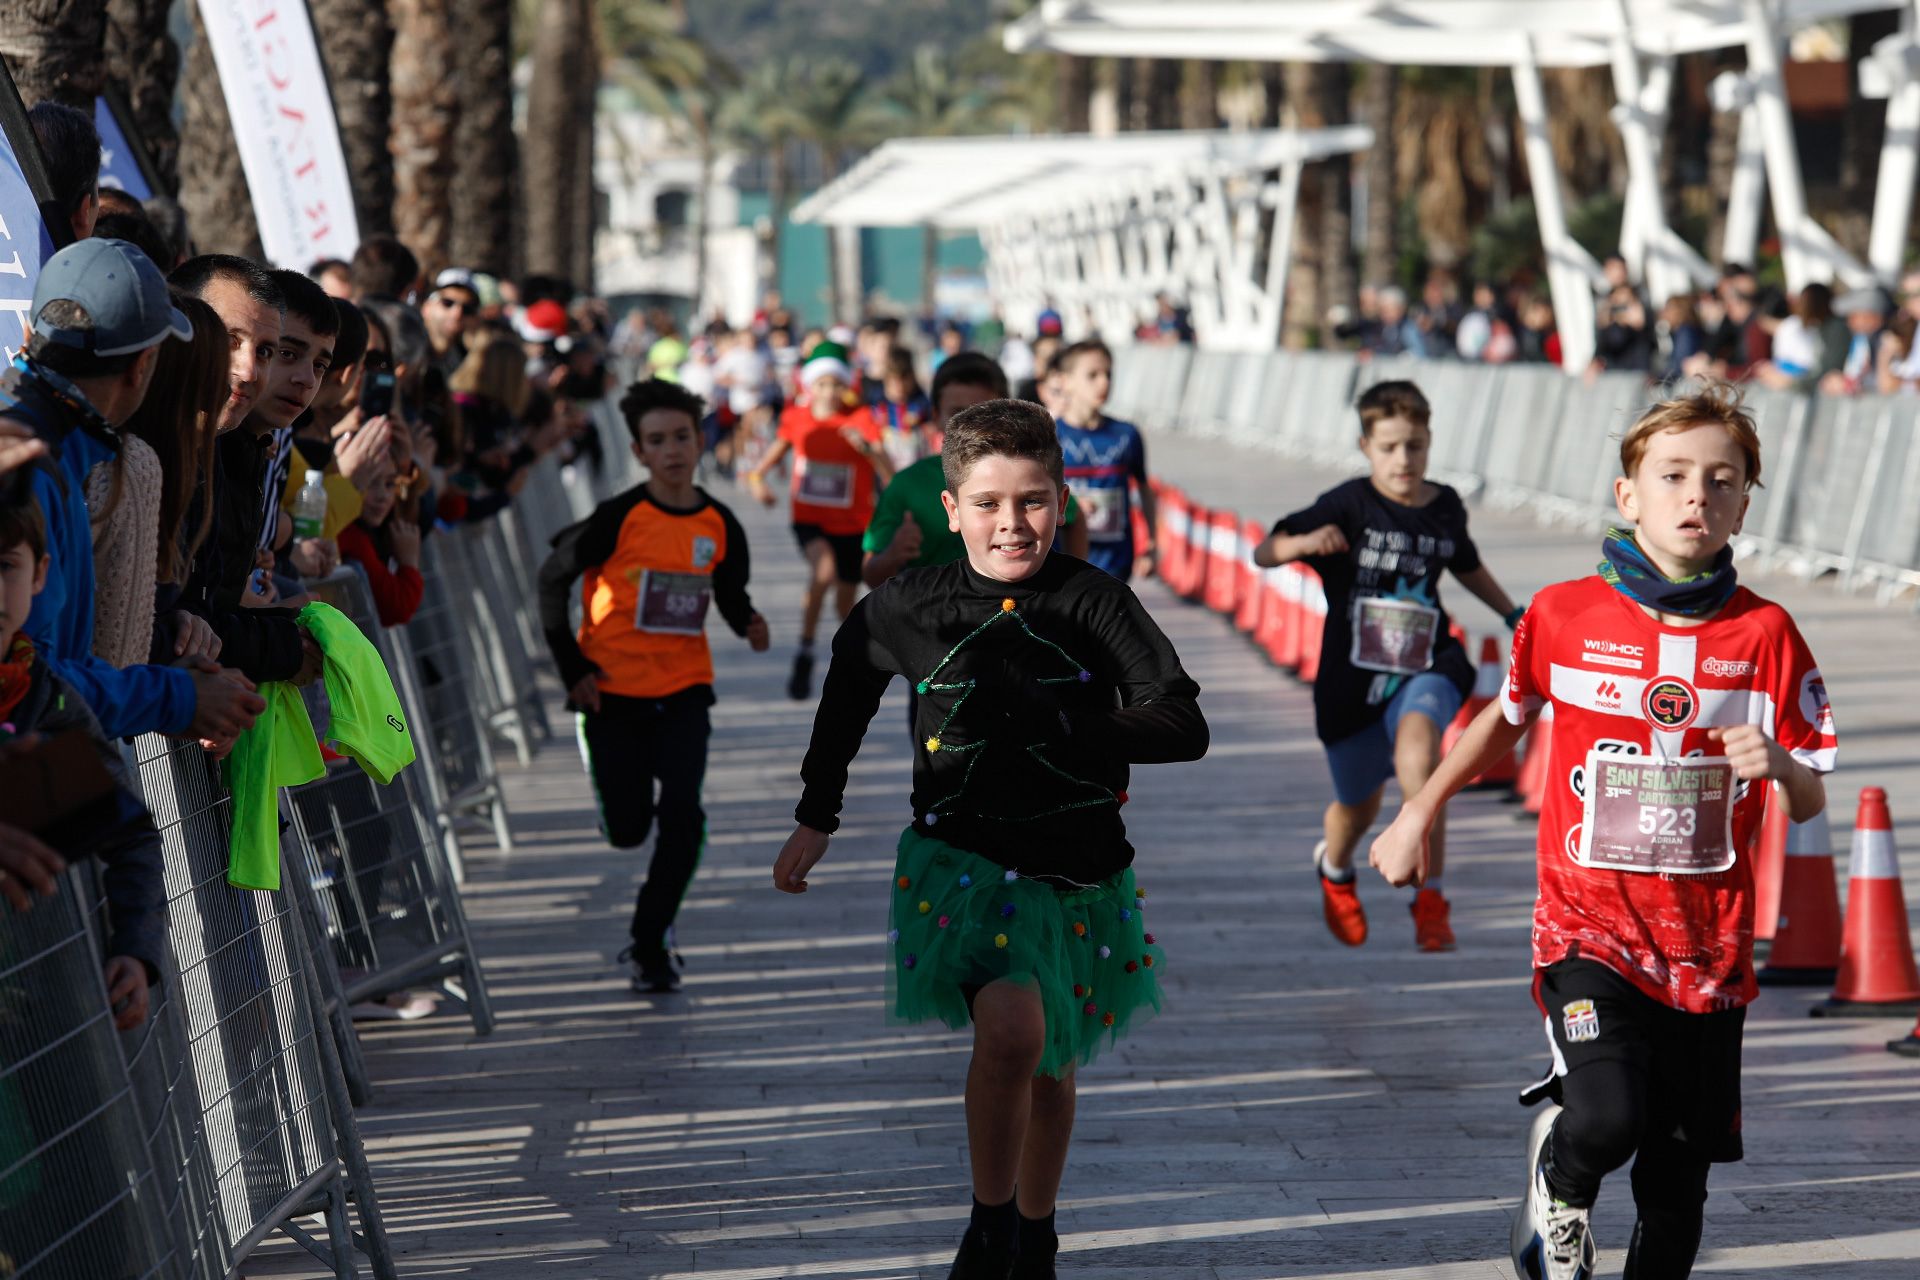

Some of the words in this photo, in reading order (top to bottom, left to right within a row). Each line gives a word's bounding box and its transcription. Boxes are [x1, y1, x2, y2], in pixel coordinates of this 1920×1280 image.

[1595, 700, 1621, 710] mobel
[1652, 694, 1689, 717] CT
[1606, 766, 1639, 787] SAN
[1641, 769, 1724, 790] SILVESTRE
[1638, 790, 1698, 805] CARTAGENA
[1701, 790, 1722, 801] 2022
[1638, 806, 1697, 836] 523
[1650, 836, 1683, 845] ADRIAN
